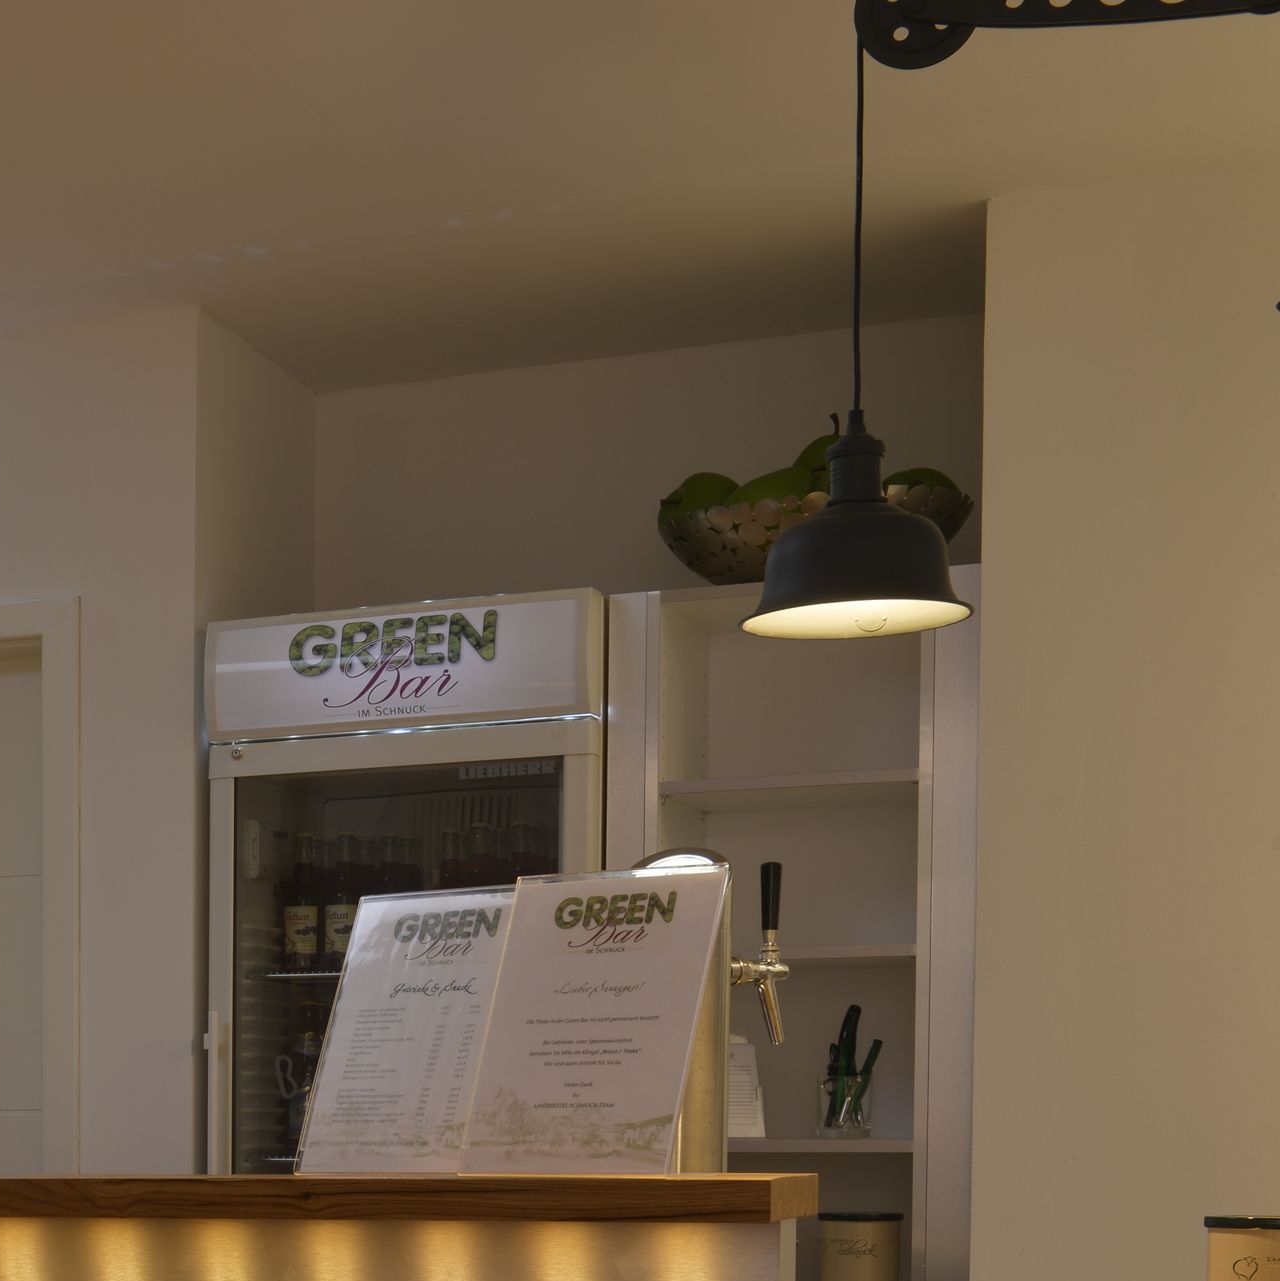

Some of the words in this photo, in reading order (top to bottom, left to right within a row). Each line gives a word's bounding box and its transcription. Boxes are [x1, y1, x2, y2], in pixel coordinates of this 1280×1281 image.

[288, 609, 498, 677] GREEN
[322, 634, 459, 708] Bar
[459, 760, 557, 780] LIEBHERR
[394, 907, 503, 943] GREEN
[554, 890, 678, 930] GREEN
[567, 907, 649, 948] Bar
[404, 925, 475, 961] Bar
